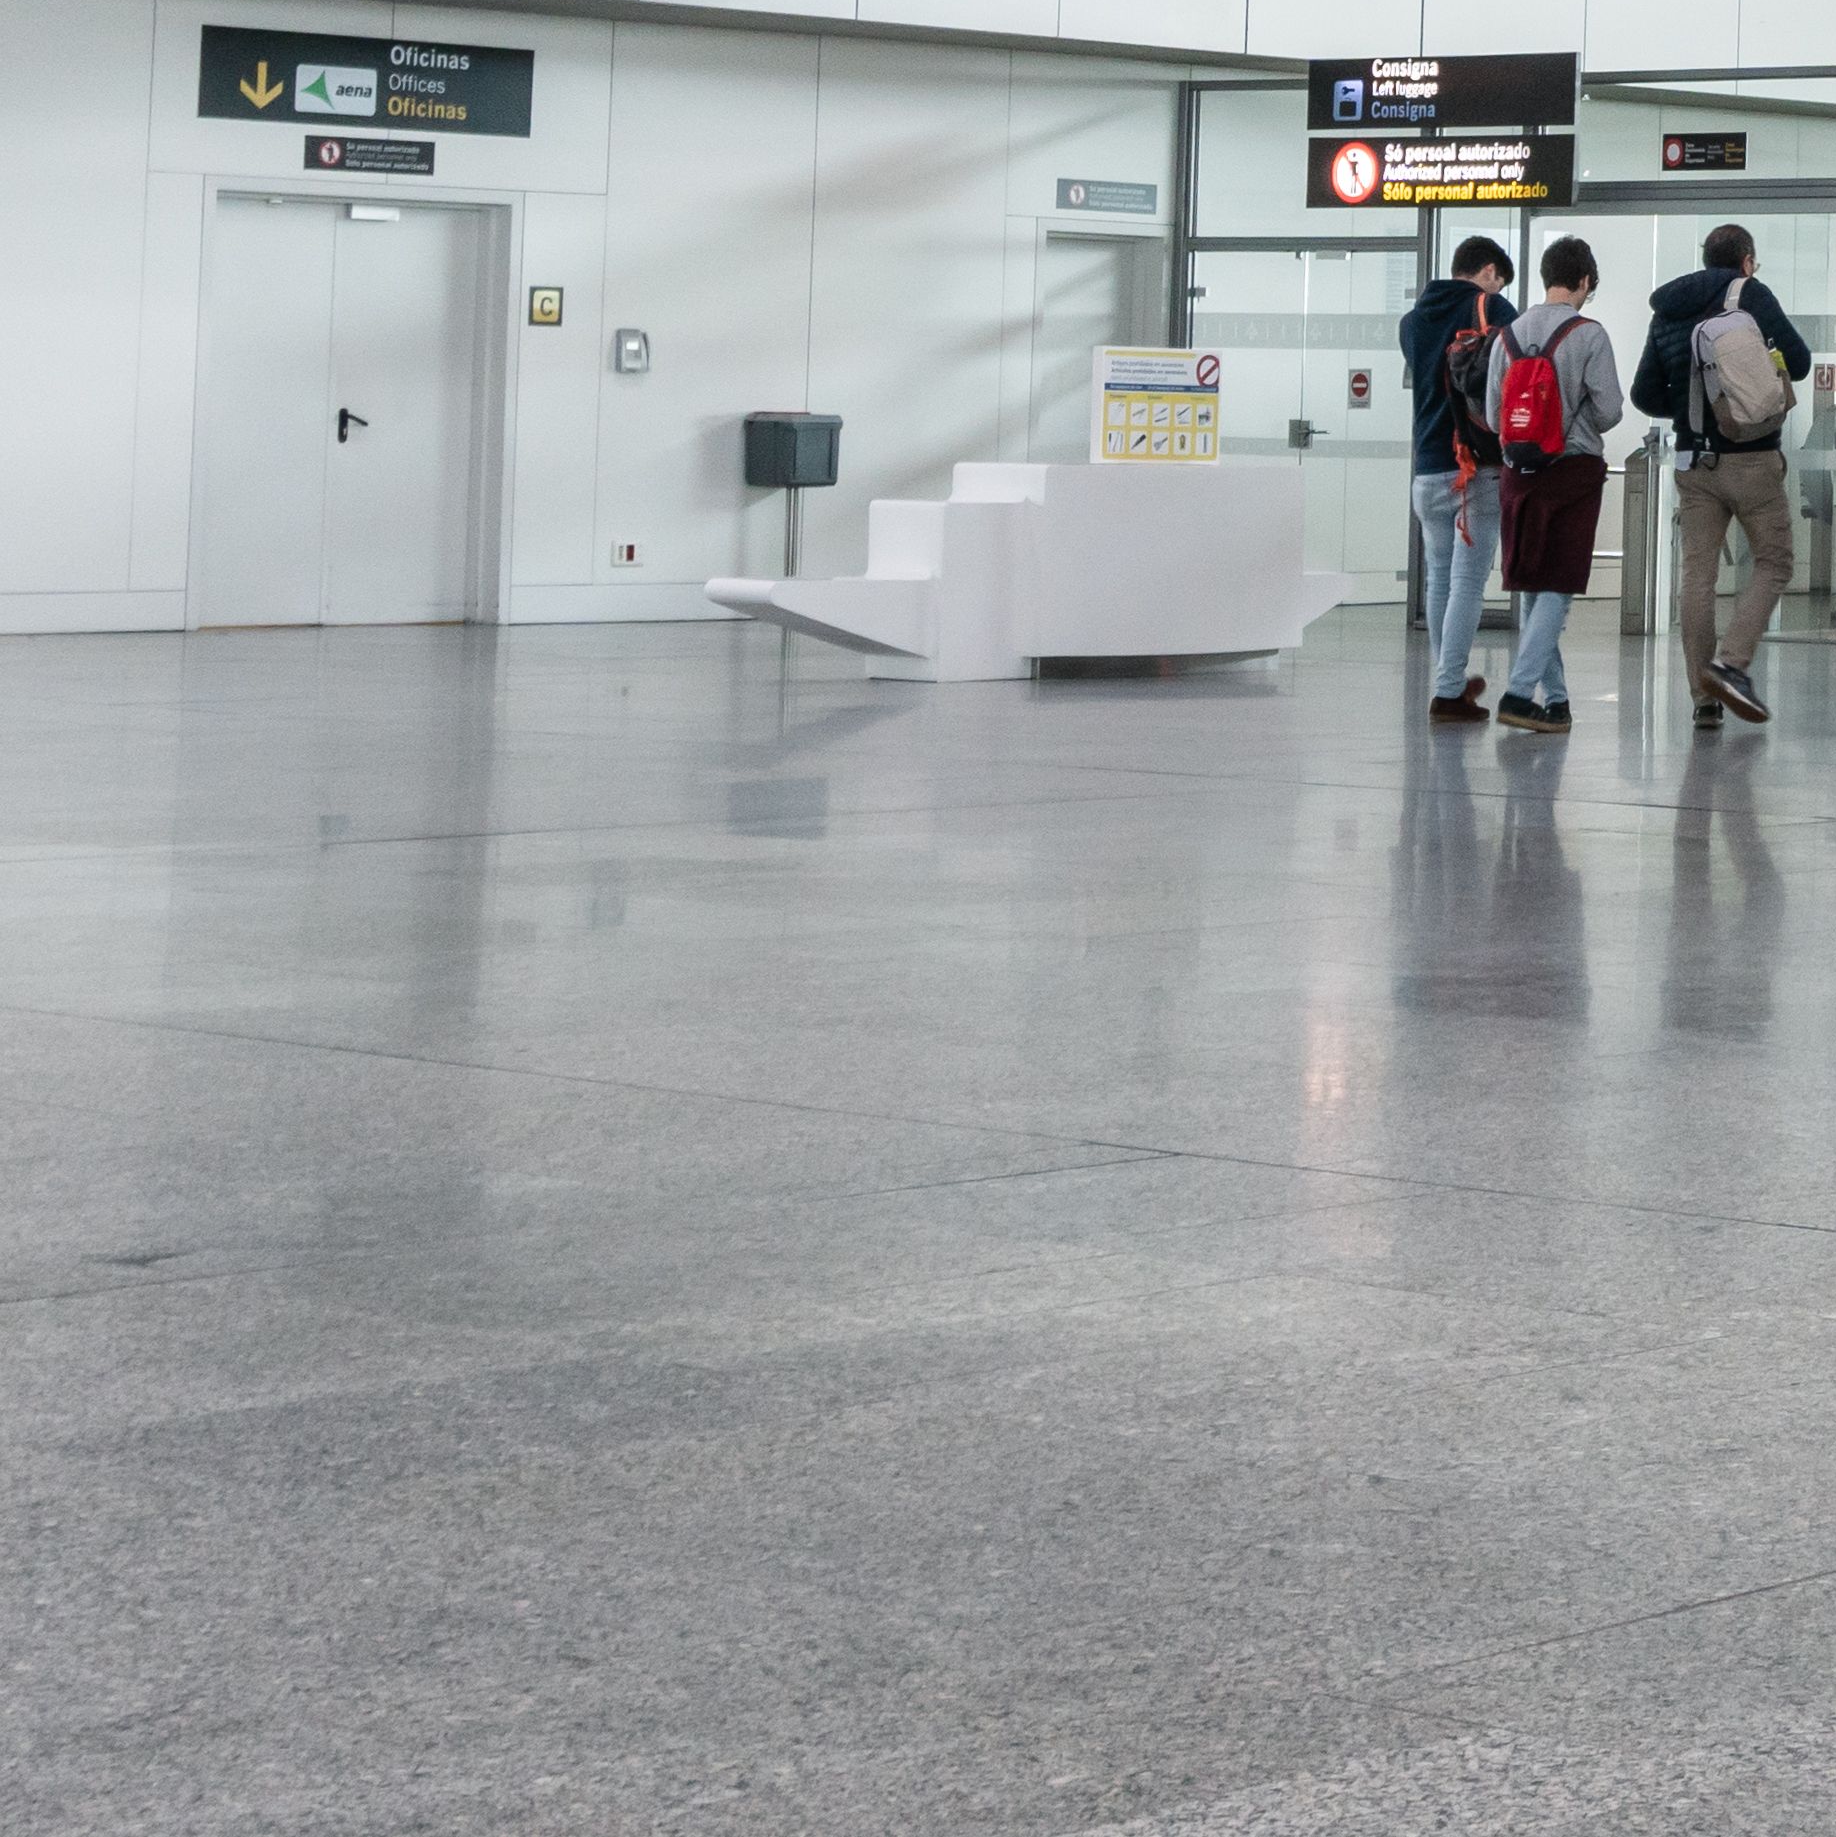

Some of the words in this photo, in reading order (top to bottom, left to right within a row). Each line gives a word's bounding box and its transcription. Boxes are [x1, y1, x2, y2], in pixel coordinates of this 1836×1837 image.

[390, 45, 470, 71] Oficinas
[1371, 58, 1439, 81] Consigna
[335, 85, 373, 98] aena
[388, 73, 446, 94] Offices
[1372, 80, 1394, 97] Left
[1396, 80, 1438, 98] luggage
[387, 95, 468, 121] Oficinas
[1371, 100, 1436, 122] Consigna
[1384, 142, 1403, 162] Só
[1404, 142, 1457, 164] persoal
[1457, 142, 1531, 161] autorizado
[1383, 163, 1442, 181] Authorized
[1443, 162, 1498, 182] personnel
[1500, 161, 1525, 181] only
[1383, 182, 1413, 201] Sólo
[1415, 180, 1474, 203] personal
[1476, 180, 1548, 199] autorizado
